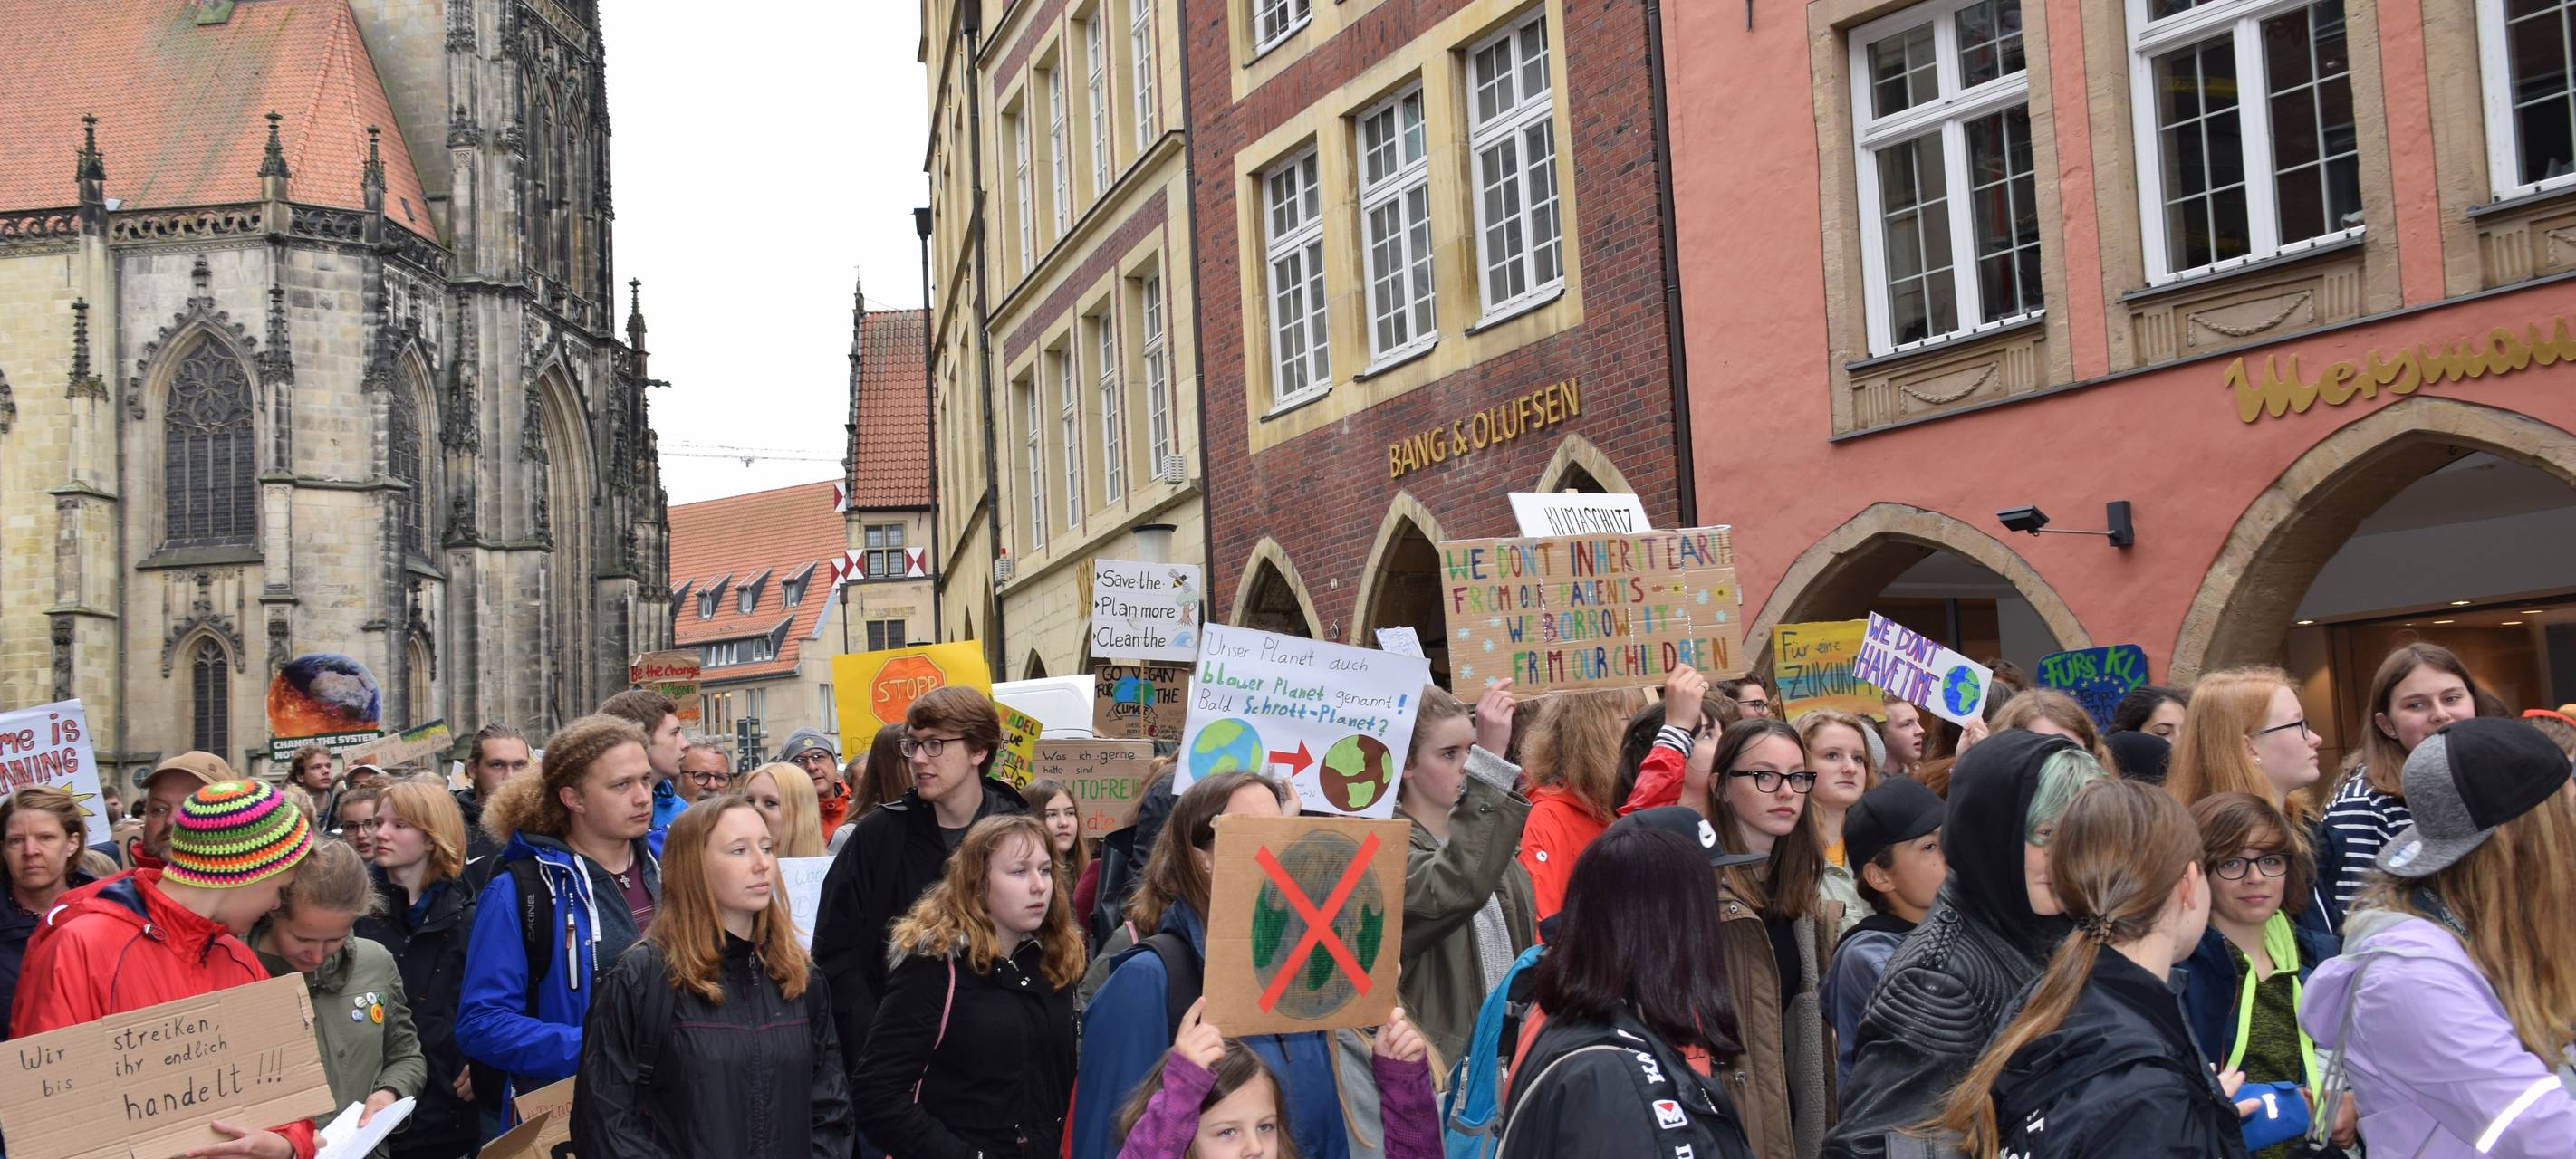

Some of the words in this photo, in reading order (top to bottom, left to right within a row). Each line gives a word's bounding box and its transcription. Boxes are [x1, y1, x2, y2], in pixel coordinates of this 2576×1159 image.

[1389, 426, 1447, 478] BANG
[1452, 419, 1469, 456] &
[1471, 377, 1581, 449] OLUFSEN
[1447, 548, 1487, 580] WE
[1497, 543, 1554, 579] DON'T
[1570, 537, 1658, 577] INHERIT
[1666, 532, 1734, 570] EARTH
[1101, 570, 1136, 589] Save
[1139, 570, 1161, 590] the
[1453, 584, 1512, 614] FROM
[1520, 583, 1546, 608] OUR
[1558, 577, 1645, 608] PARENTS
[1101, 596, 1138, 618] Plan
[1141, 606, 1176, 618] more
[1507, 614, 1535, 644] WE
[1543, 608, 1629, 643] BORROW
[1644, 604, 1669, 634] IT
[1097, 627, 1140, 647] Clean
[1143, 626, 1167, 648] the
[1203, 632, 1251, 659] Unser
[1260, 637, 1314, 667] Planet
[1329, 656, 1369, 673] auch
[1781, 631, 1808, 662] Für
[1815, 638, 1841, 655] eine
[1869, 614, 1895, 646] WE
[1895, 627, 1944, 667] DON'T
[630, 665, 643, 682] Be
[646, 664, 663, 678] the
[1102, 666, 1122, 681] GO
[1130, 666, 1176, 683] VEGAN
[1513, 650, 1564, 686] FROM
[1572, 647, 1609, 680] OUR
[1613, 637, 1729, 677] CHILDREN
[1854, 642, 1905, 694] HAVE
[1900, 661, 1941, 712] TIME
[2041, 652, 2099, 688] FÜRS
[876, 675, 938, 704] STOPP
[1095, 683, 1114, 699] FOR
[1155, 687, 1180, 704] THE
[1201, 661, 1264, 691] blauer
[1274, 676, 1325, 702] Planet
[1115, 704, 1149, 715] CLIMAE
[1197, 687, 1233, 713] Bald
[1243, 694, 1389, 737] Schrott-Planet?
[0, 728, 34, 756] me
[49, 713, 81, 746] is
[274, 737, 315, 750] CHANGE
[316, 735, 337, 746] THE
[337, 733, 379, 744] SYSTEM
[1042, 750, 1067, 761] Was
[1079, 750, 1091, 760] ich
[1100, 752, 1136, 765] gerne
[1076, 765, 1093, 774] sind
[20, 1045, 65, 1071] Wir
[114, 1017, 221, 1051] streiken,
[43, 1078, 73, 1097] bis
[115, 1055, 144, 1077] ihr
[164, 1035, 228, 1066] endlich
[123, 1063, 244, 1122] handelt
